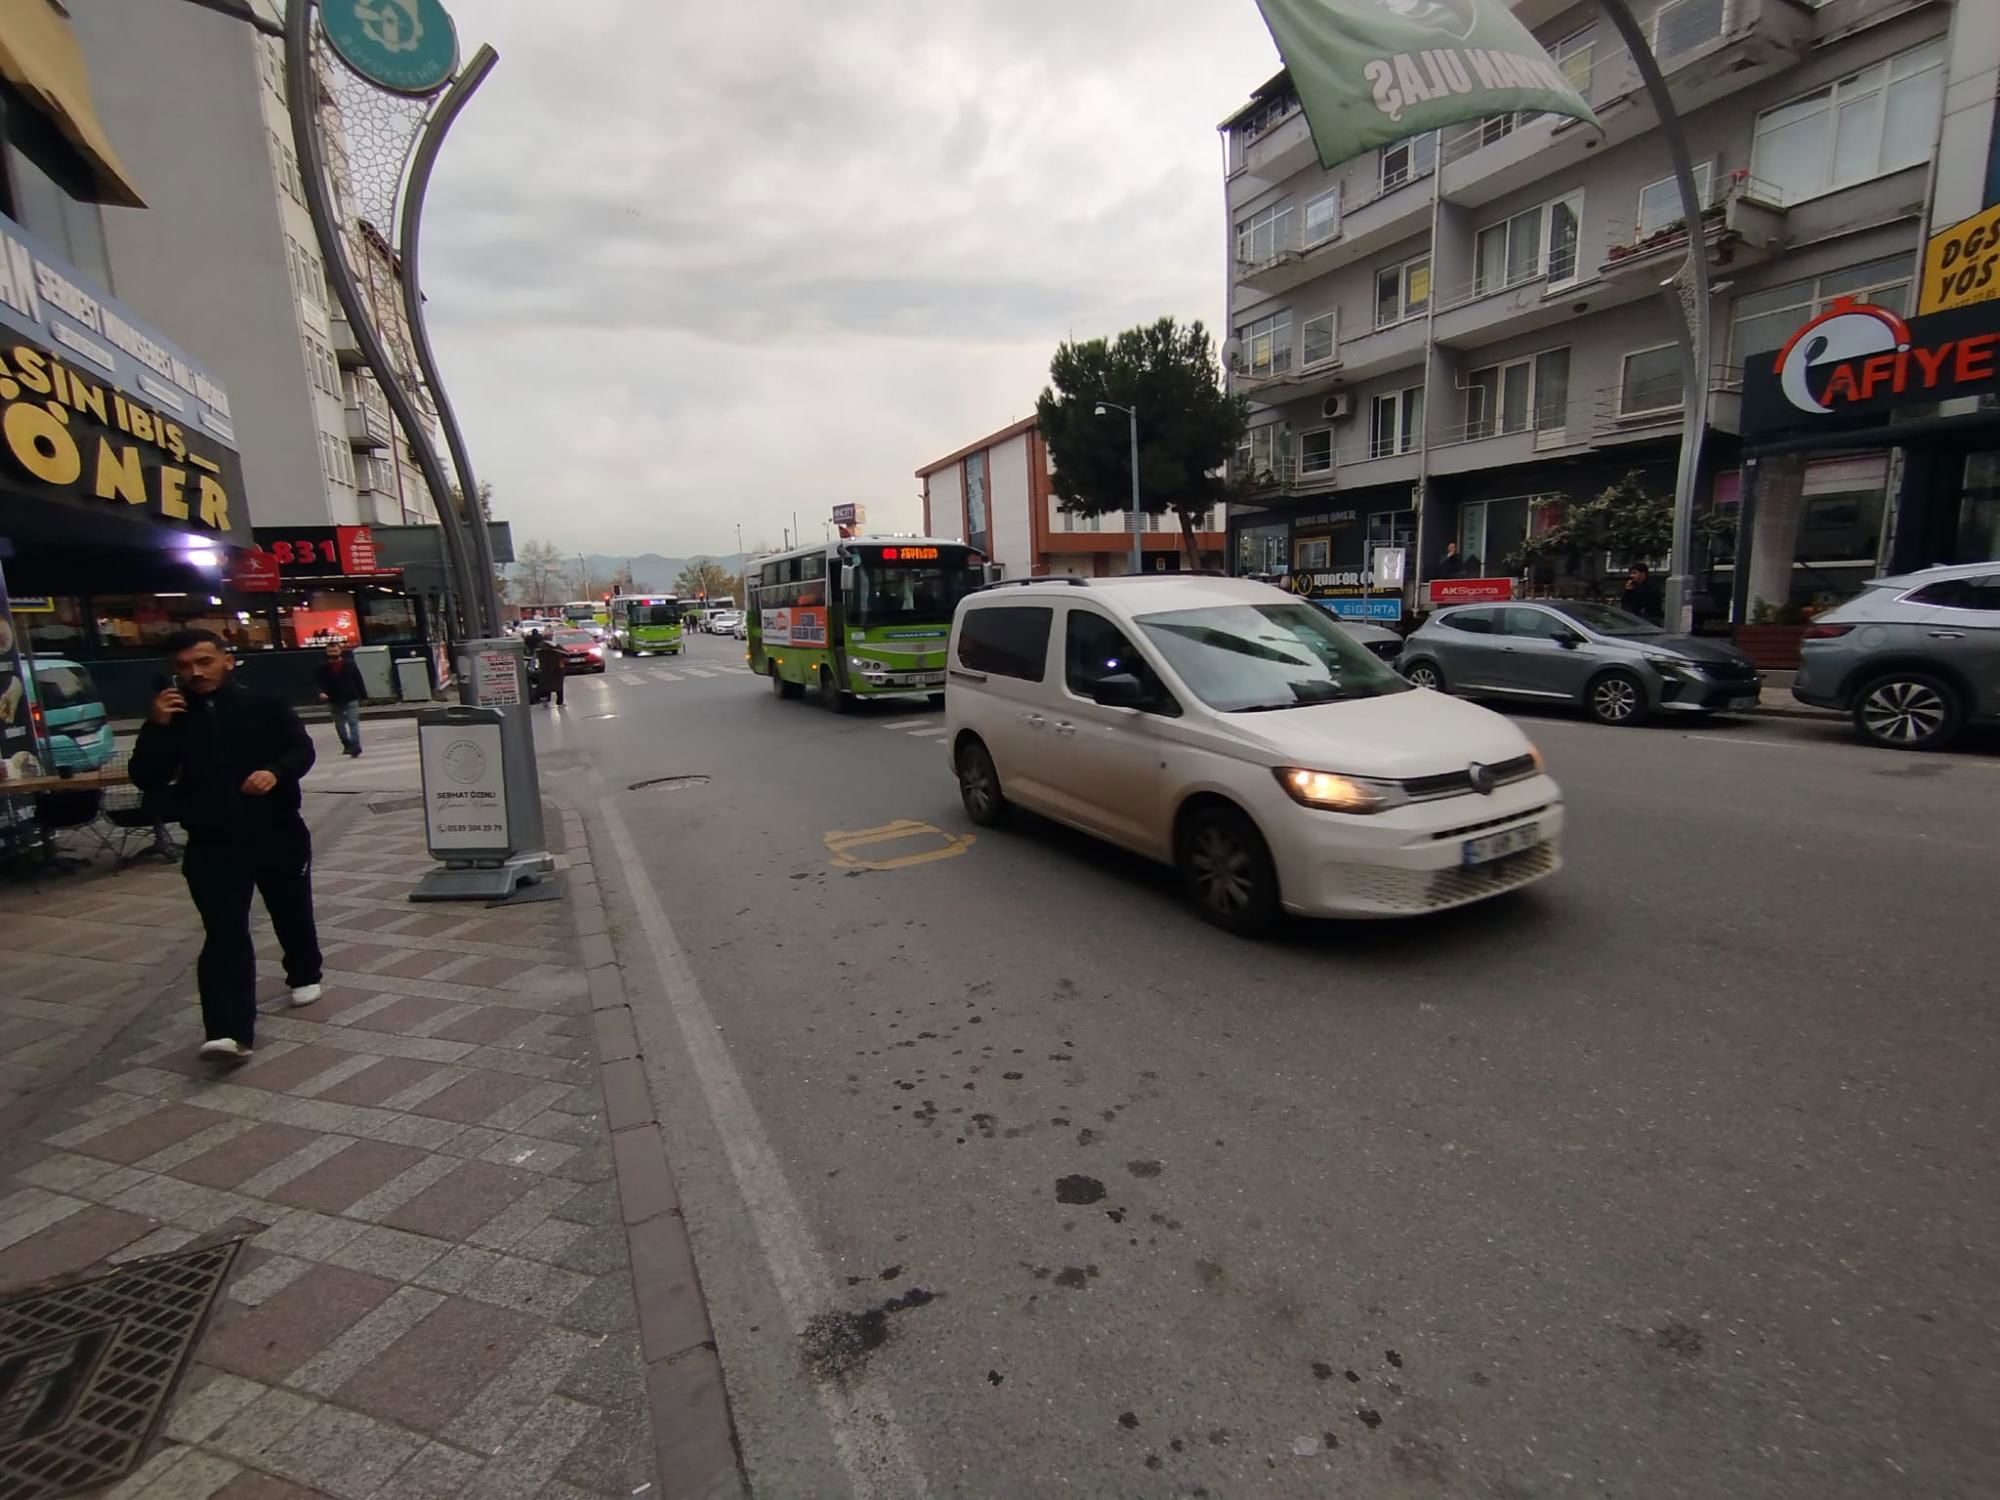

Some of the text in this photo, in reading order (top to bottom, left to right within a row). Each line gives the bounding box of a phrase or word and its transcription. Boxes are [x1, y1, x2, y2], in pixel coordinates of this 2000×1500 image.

[1941, 216, 2000, 269] DGS
[1938, 253, 1999, 304] YÖS
[1820, 331, 2000, 407] AFİYE
[111, 383, 187, 463] İBİŞ
